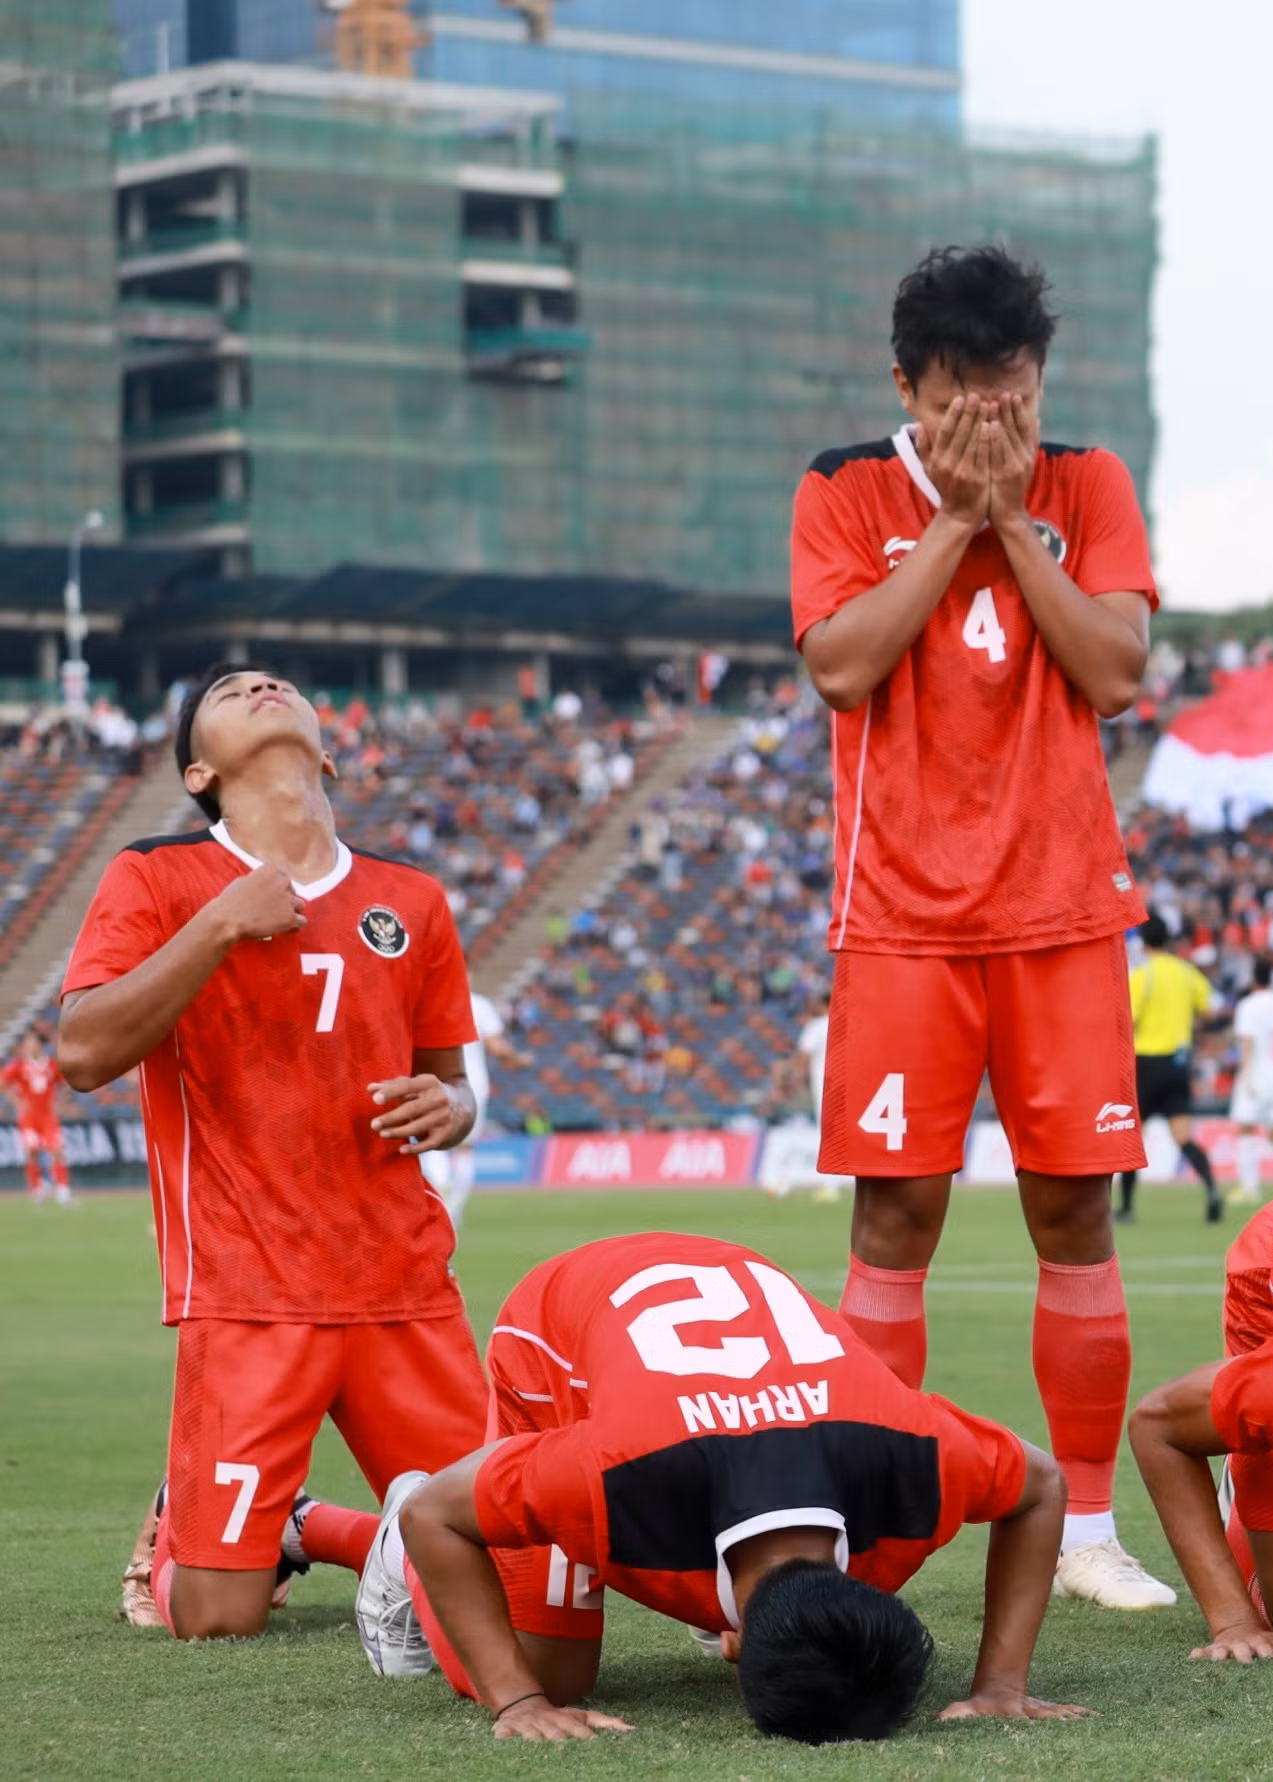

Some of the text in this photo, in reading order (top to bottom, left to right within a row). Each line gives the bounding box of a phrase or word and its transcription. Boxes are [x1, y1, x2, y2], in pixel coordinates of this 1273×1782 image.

[962, 587, 1006, 663] 4
[300, 953, 345, 1032] 7
[858, 1072, 908, 1151] 4
[609, 1261, 845, 1379] 12
[677, 1380, 829, 1433] ARHAN
[215, 1461, 260, 1543] 7
